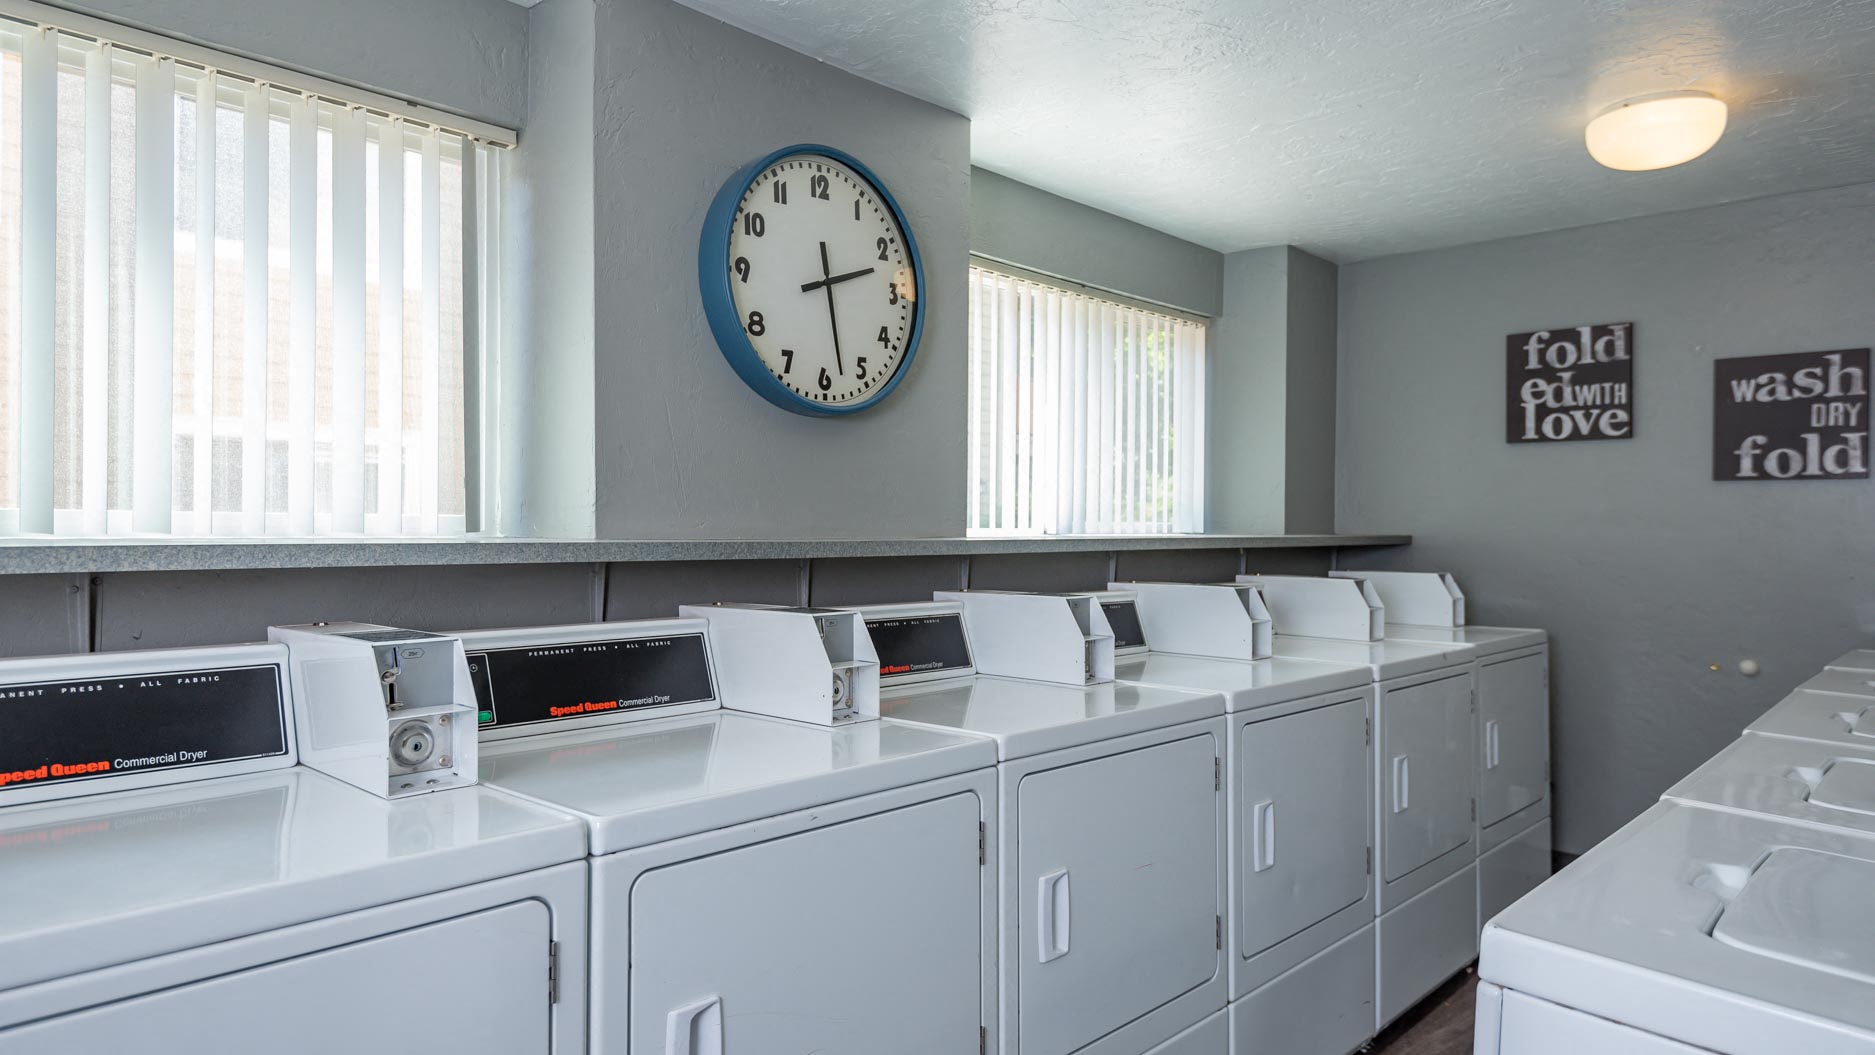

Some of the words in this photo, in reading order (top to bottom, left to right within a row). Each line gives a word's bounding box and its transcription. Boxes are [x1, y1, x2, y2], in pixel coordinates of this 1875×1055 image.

[774, 179, 787, 204] 11
[811, 174, 830, 200] 12
[854, 198, 860, 220] 1
[744, 212, 765, 238] 10
[876, 236, 889, 262] 2
[734, 256, 750, 283] 9
[888, 282, 898, 306] 3
[748, 310, 766, 336] 8
[877, 326, 890, 349] 4
[1523, 324, 1631, 370] fold
[781, 349, 794, 374] 7
[856, 356, 867, 380] 5
[818, 367, 832, 391] 6
[1731, 354, 1867, 402] wash
[1574, 382, 1627, 406] WITH
[1520, 401, 1630, 440] love
[1811, 402, 1862, 428] DRY
[1734, 432, 1868, 479] fold
[528, 648, 574, 657] PERMANENT
[61, 684, 102, 694] PRESS
[140, 680, 162, 688] ALL
[178, 675, 220, 685] FABRIC
[550, 703, 584, 717] Speed
[584, 700, 618, 712] Queen
[618, 696, 653, 707] Commercial
[654, 695, 670, 704] Dryer
[50, 760, 110, 777] Queen
[114, 752, 177, 769] Commercial
[179, 750, 208, 762] Dryer
